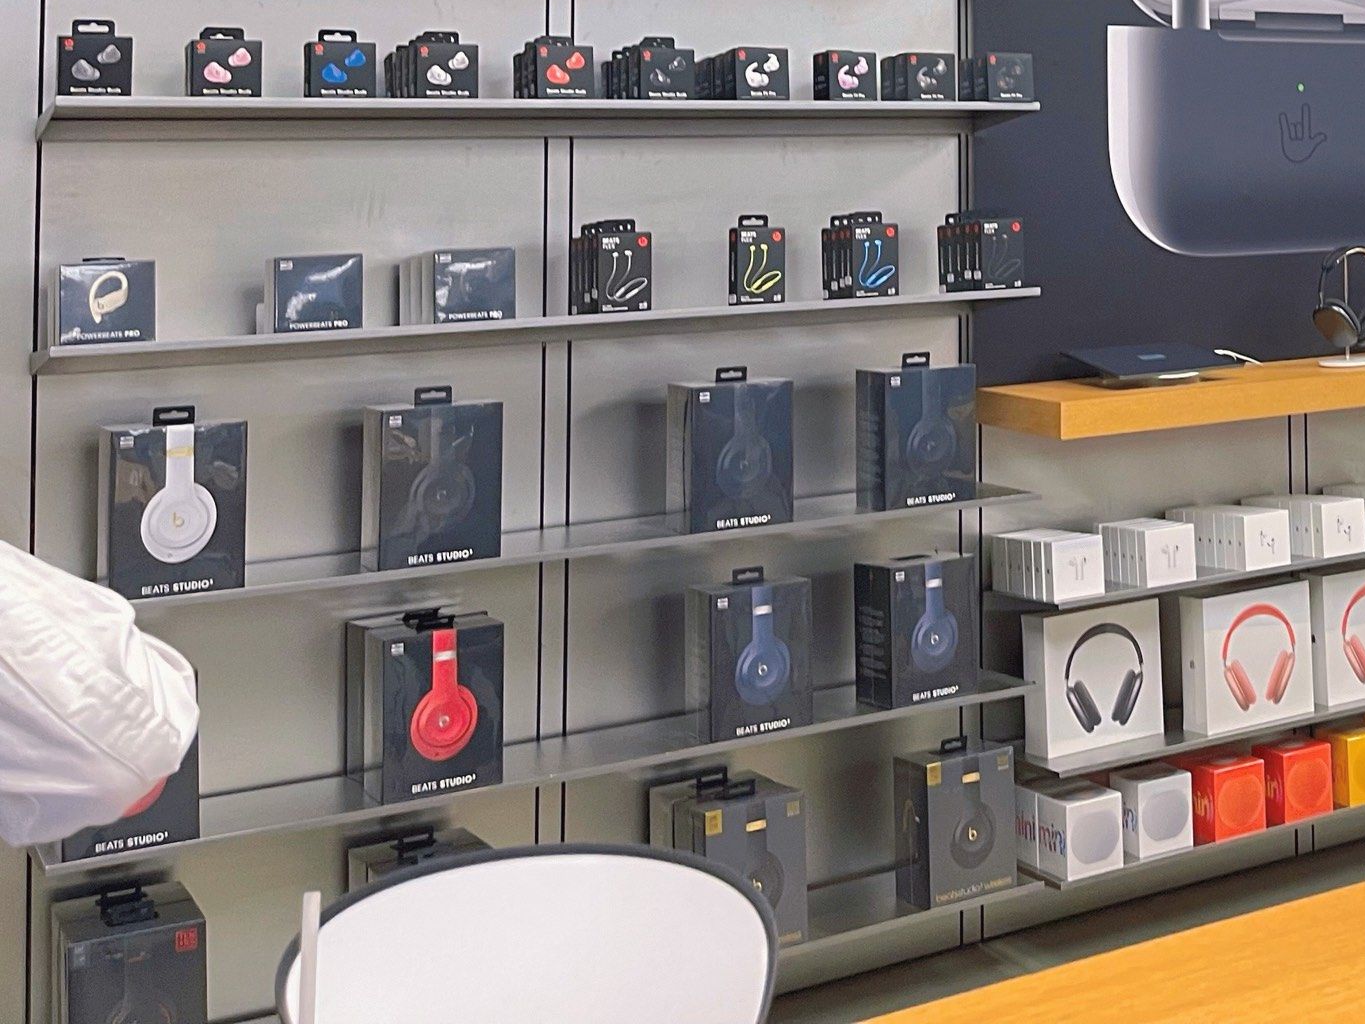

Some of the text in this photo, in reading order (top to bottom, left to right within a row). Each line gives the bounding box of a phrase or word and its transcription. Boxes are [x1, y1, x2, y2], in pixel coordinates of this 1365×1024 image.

[334, 320, 348, 328] PRO
[124, 329, 140, 338] PRO
[717, 519, 738, 529] BEATS
[408, 553, 434, 565] BEATS
[141, 584, 169, 596] BEATS
[736, 726, 758, 736] BEATS
[412, 783, 437, 794] BEATS
[95, 839, 124, 853] BEATS
